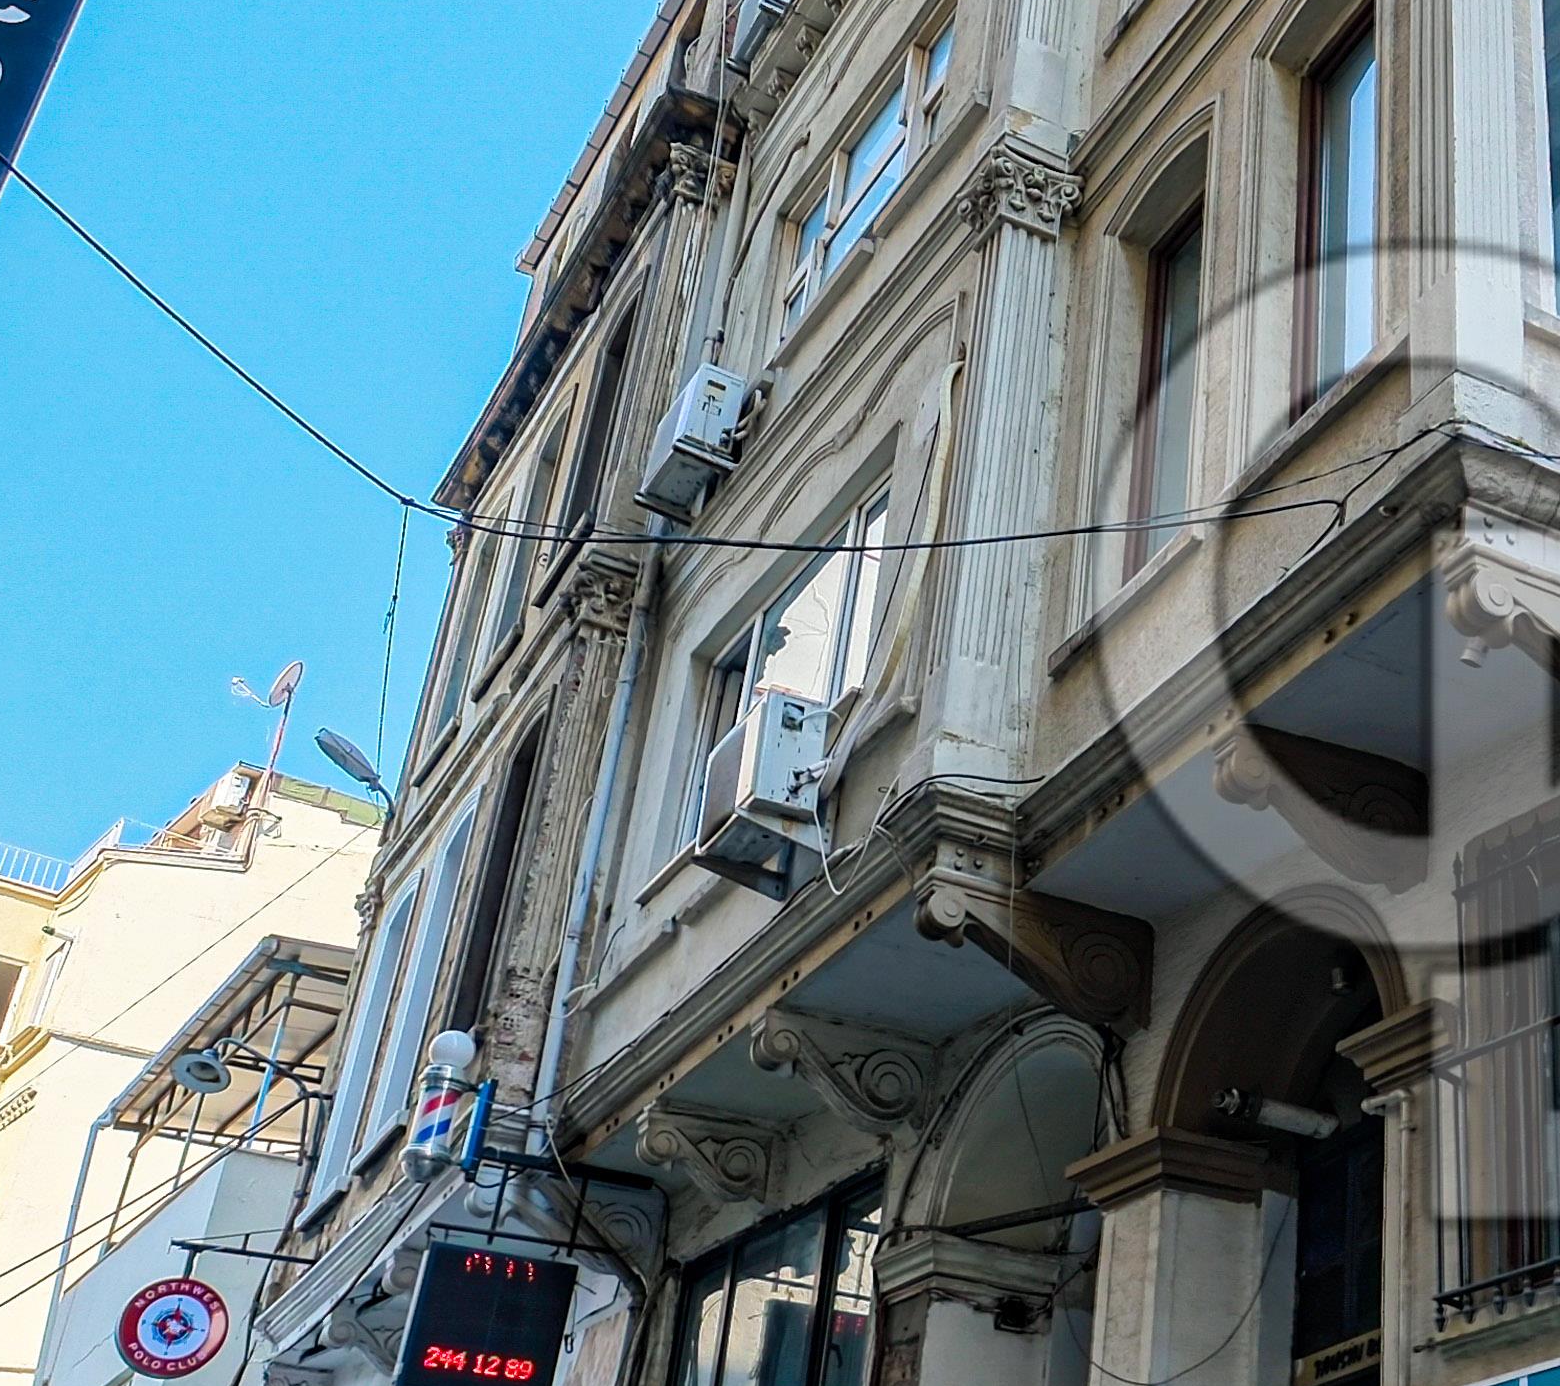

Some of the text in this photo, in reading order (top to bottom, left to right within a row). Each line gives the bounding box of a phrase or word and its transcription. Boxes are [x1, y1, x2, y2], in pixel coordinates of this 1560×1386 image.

[134, 1281, 224, 1317] NORTHWES
[128, 1342, 161, 1370] POLO
[472, 1354, 501, 1376] 12
